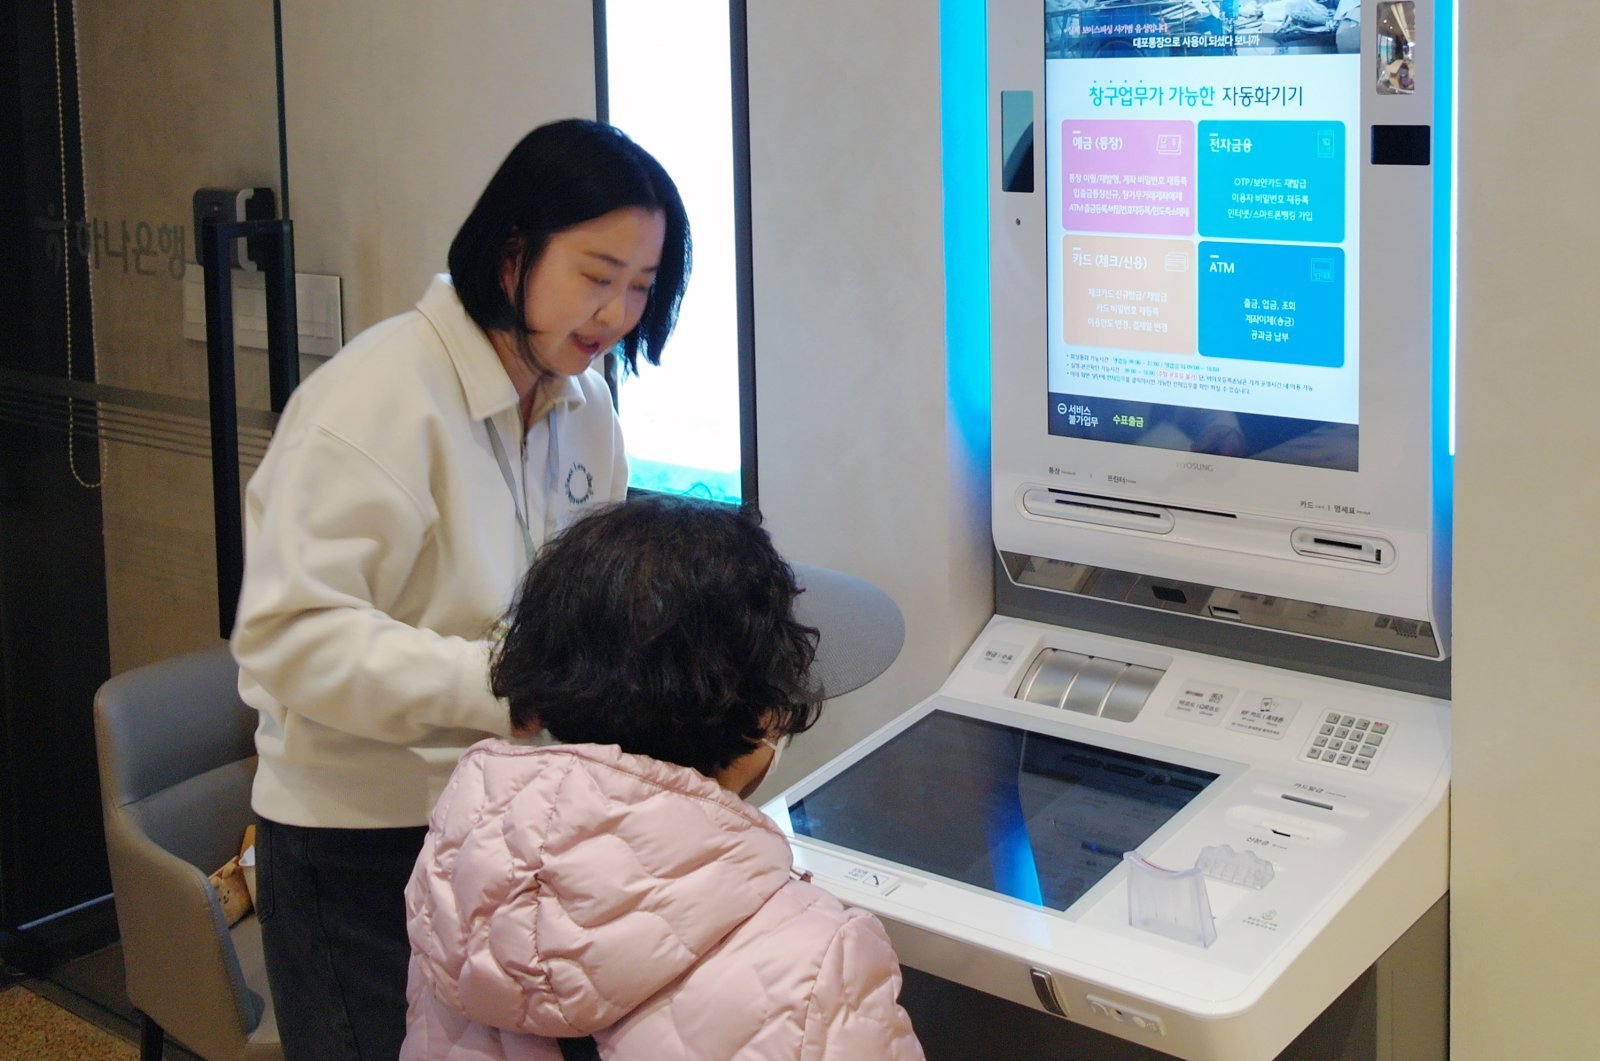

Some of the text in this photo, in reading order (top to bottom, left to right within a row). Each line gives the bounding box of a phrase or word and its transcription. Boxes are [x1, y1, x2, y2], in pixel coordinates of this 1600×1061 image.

[1114, 24, 1133, 35] 사기범
[1132, 35, 1260, 49] 대포통장으로 사용이 되셨다 보니까
[1089, 85, 1303, 107] 창구업무가 가능한 자동화기기
[1071, 136, 1124, 151] 예금 (통장)
[1233, 177, 1307, 190] OTP/보안카드 재발급
[1231, 193, 1309, 206] 이용자 비밀번호 재등록
[1298, 210, 1313, 222] 가입
[1072, 252, 1148, 270] 카드 (체크/신용)
[1209, 260, 1235, 273] ATM
[1087, 287, 1114, 298] 체크카드
[1096, 303, 1110, 313] 카드
[1243, 297, 1296, 311] 출금, 입금, 조회
[1245, 313, 1295, 327] 계좌이체(송금)
[1251, 329, 1289, 343] 공과금 납부
[1068, 404, 1092, 416] 서비스
[1068, 415, 1099, 428] 불가업무
[1112, 414, 1145, 429] 수표출금
[1300, 500, 1314, 509] 카드
